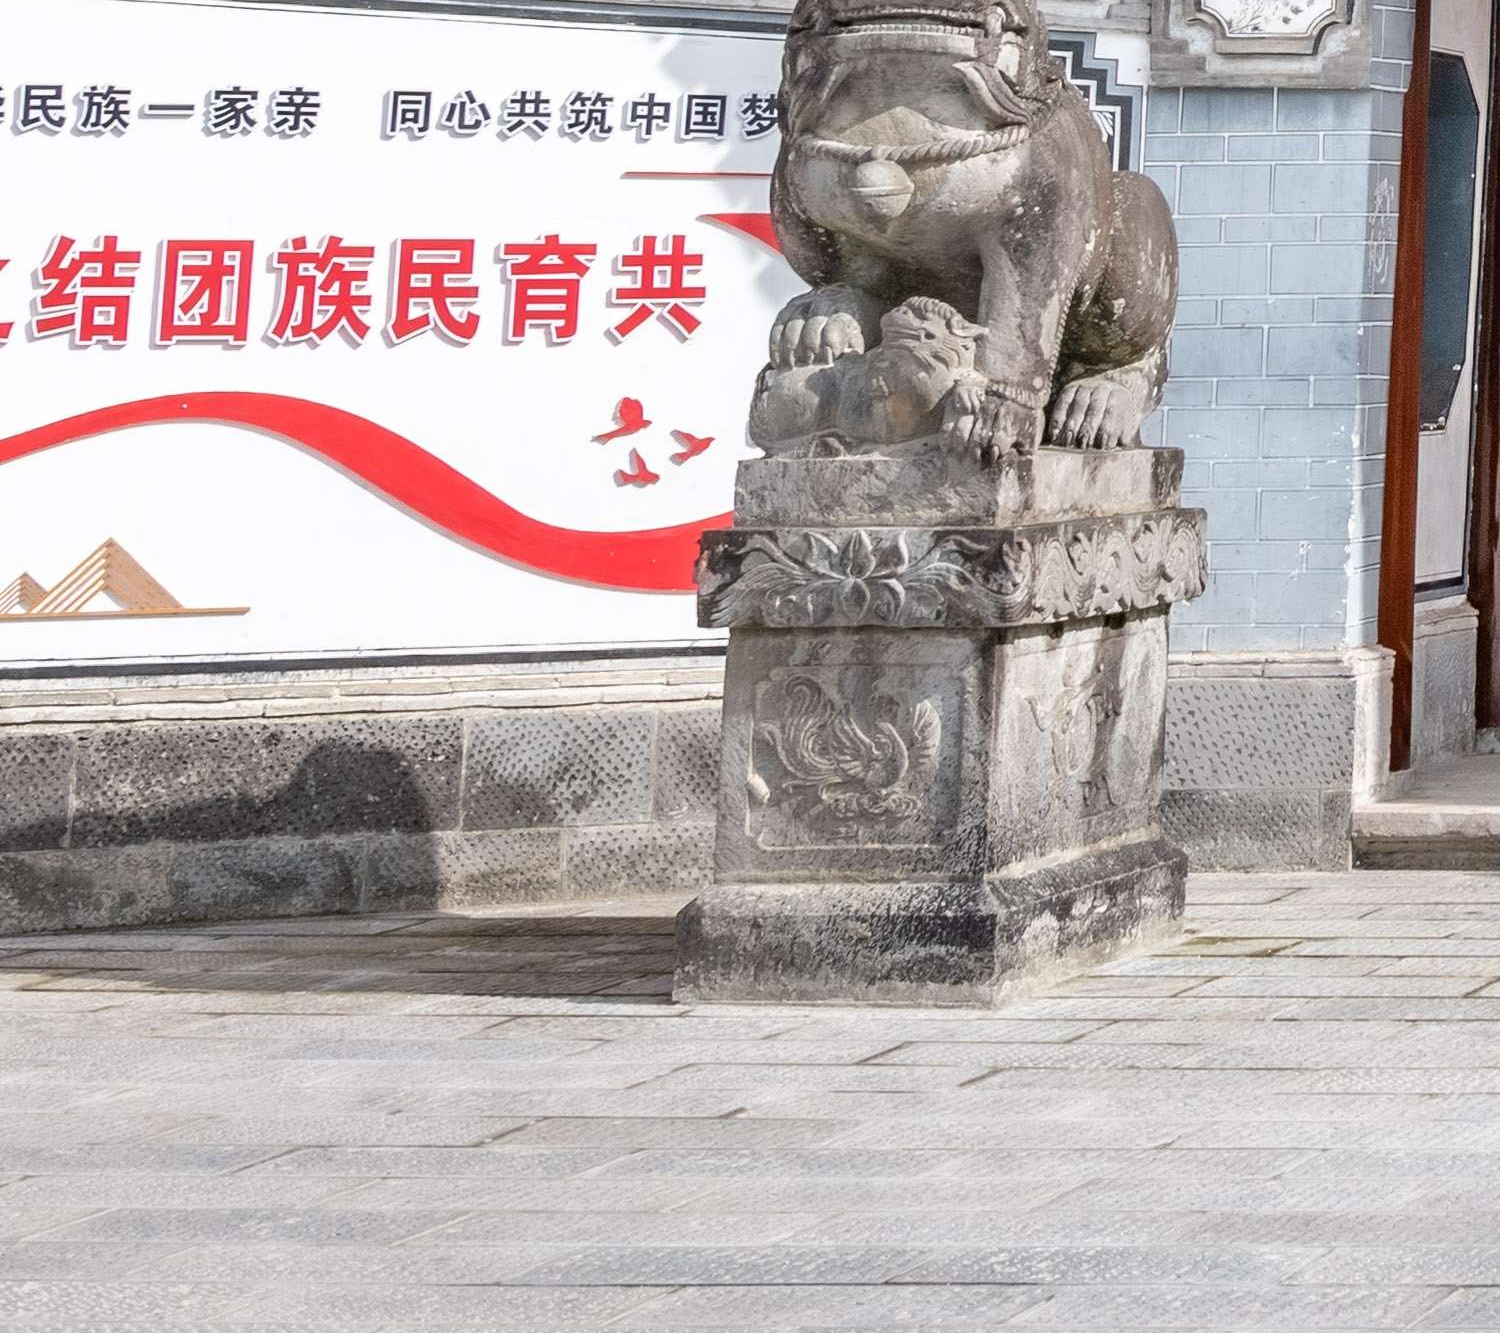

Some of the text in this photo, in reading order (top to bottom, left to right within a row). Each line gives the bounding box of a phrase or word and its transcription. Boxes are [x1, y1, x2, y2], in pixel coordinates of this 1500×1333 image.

[0, 84, 779, 137] 民族一家亲 同心共筑中国梦
